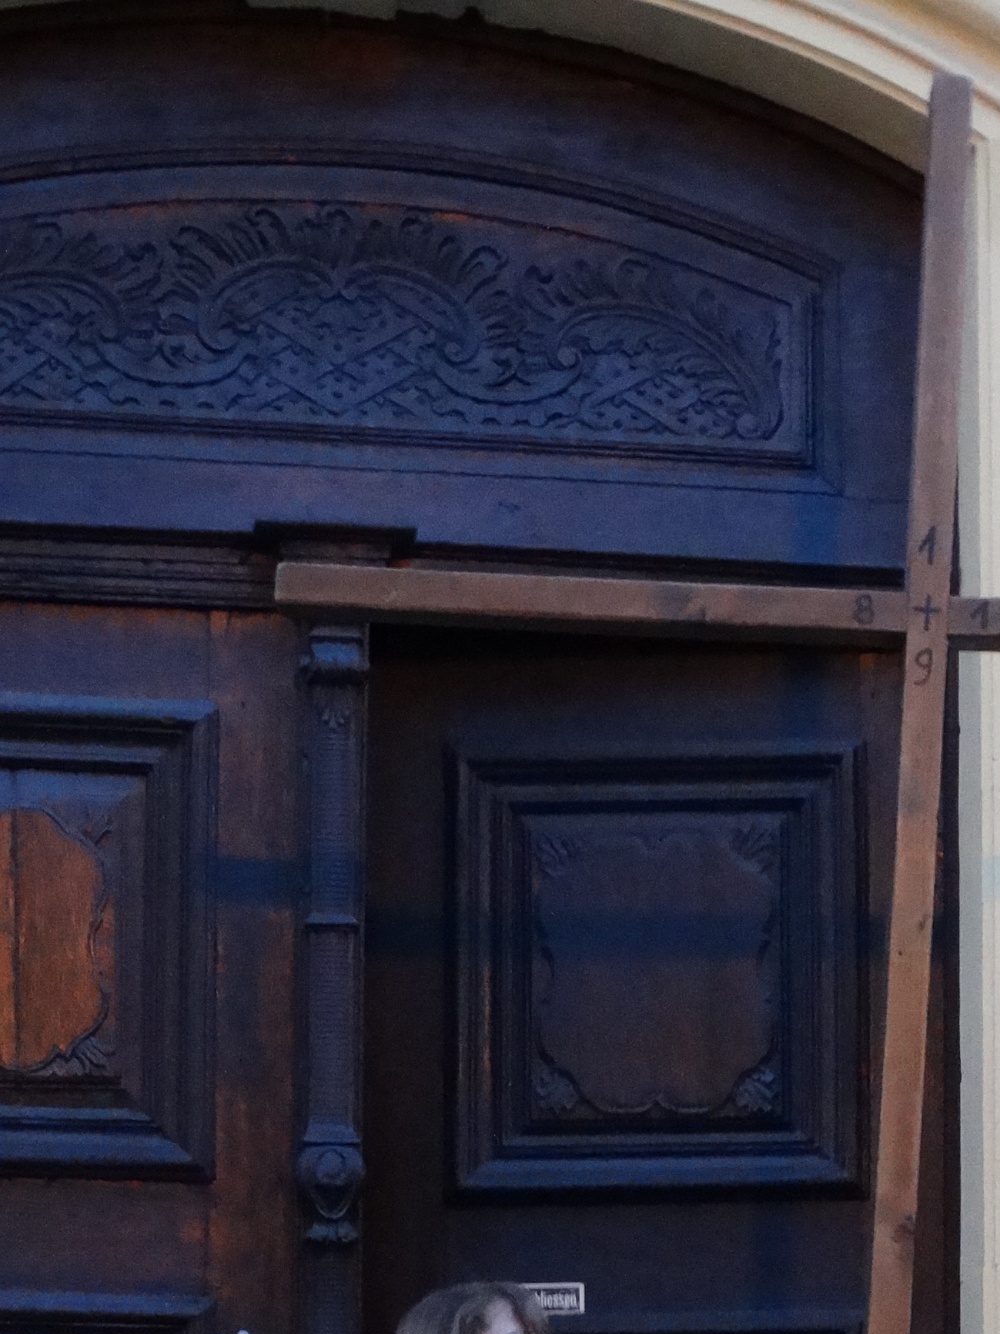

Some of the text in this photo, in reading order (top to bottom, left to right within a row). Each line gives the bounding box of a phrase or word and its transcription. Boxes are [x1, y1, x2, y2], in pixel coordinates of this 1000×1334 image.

[917, 525, 936, 566] 1
[853, 593, 875, 625] 8
[913, 647, 933, 686] 9
